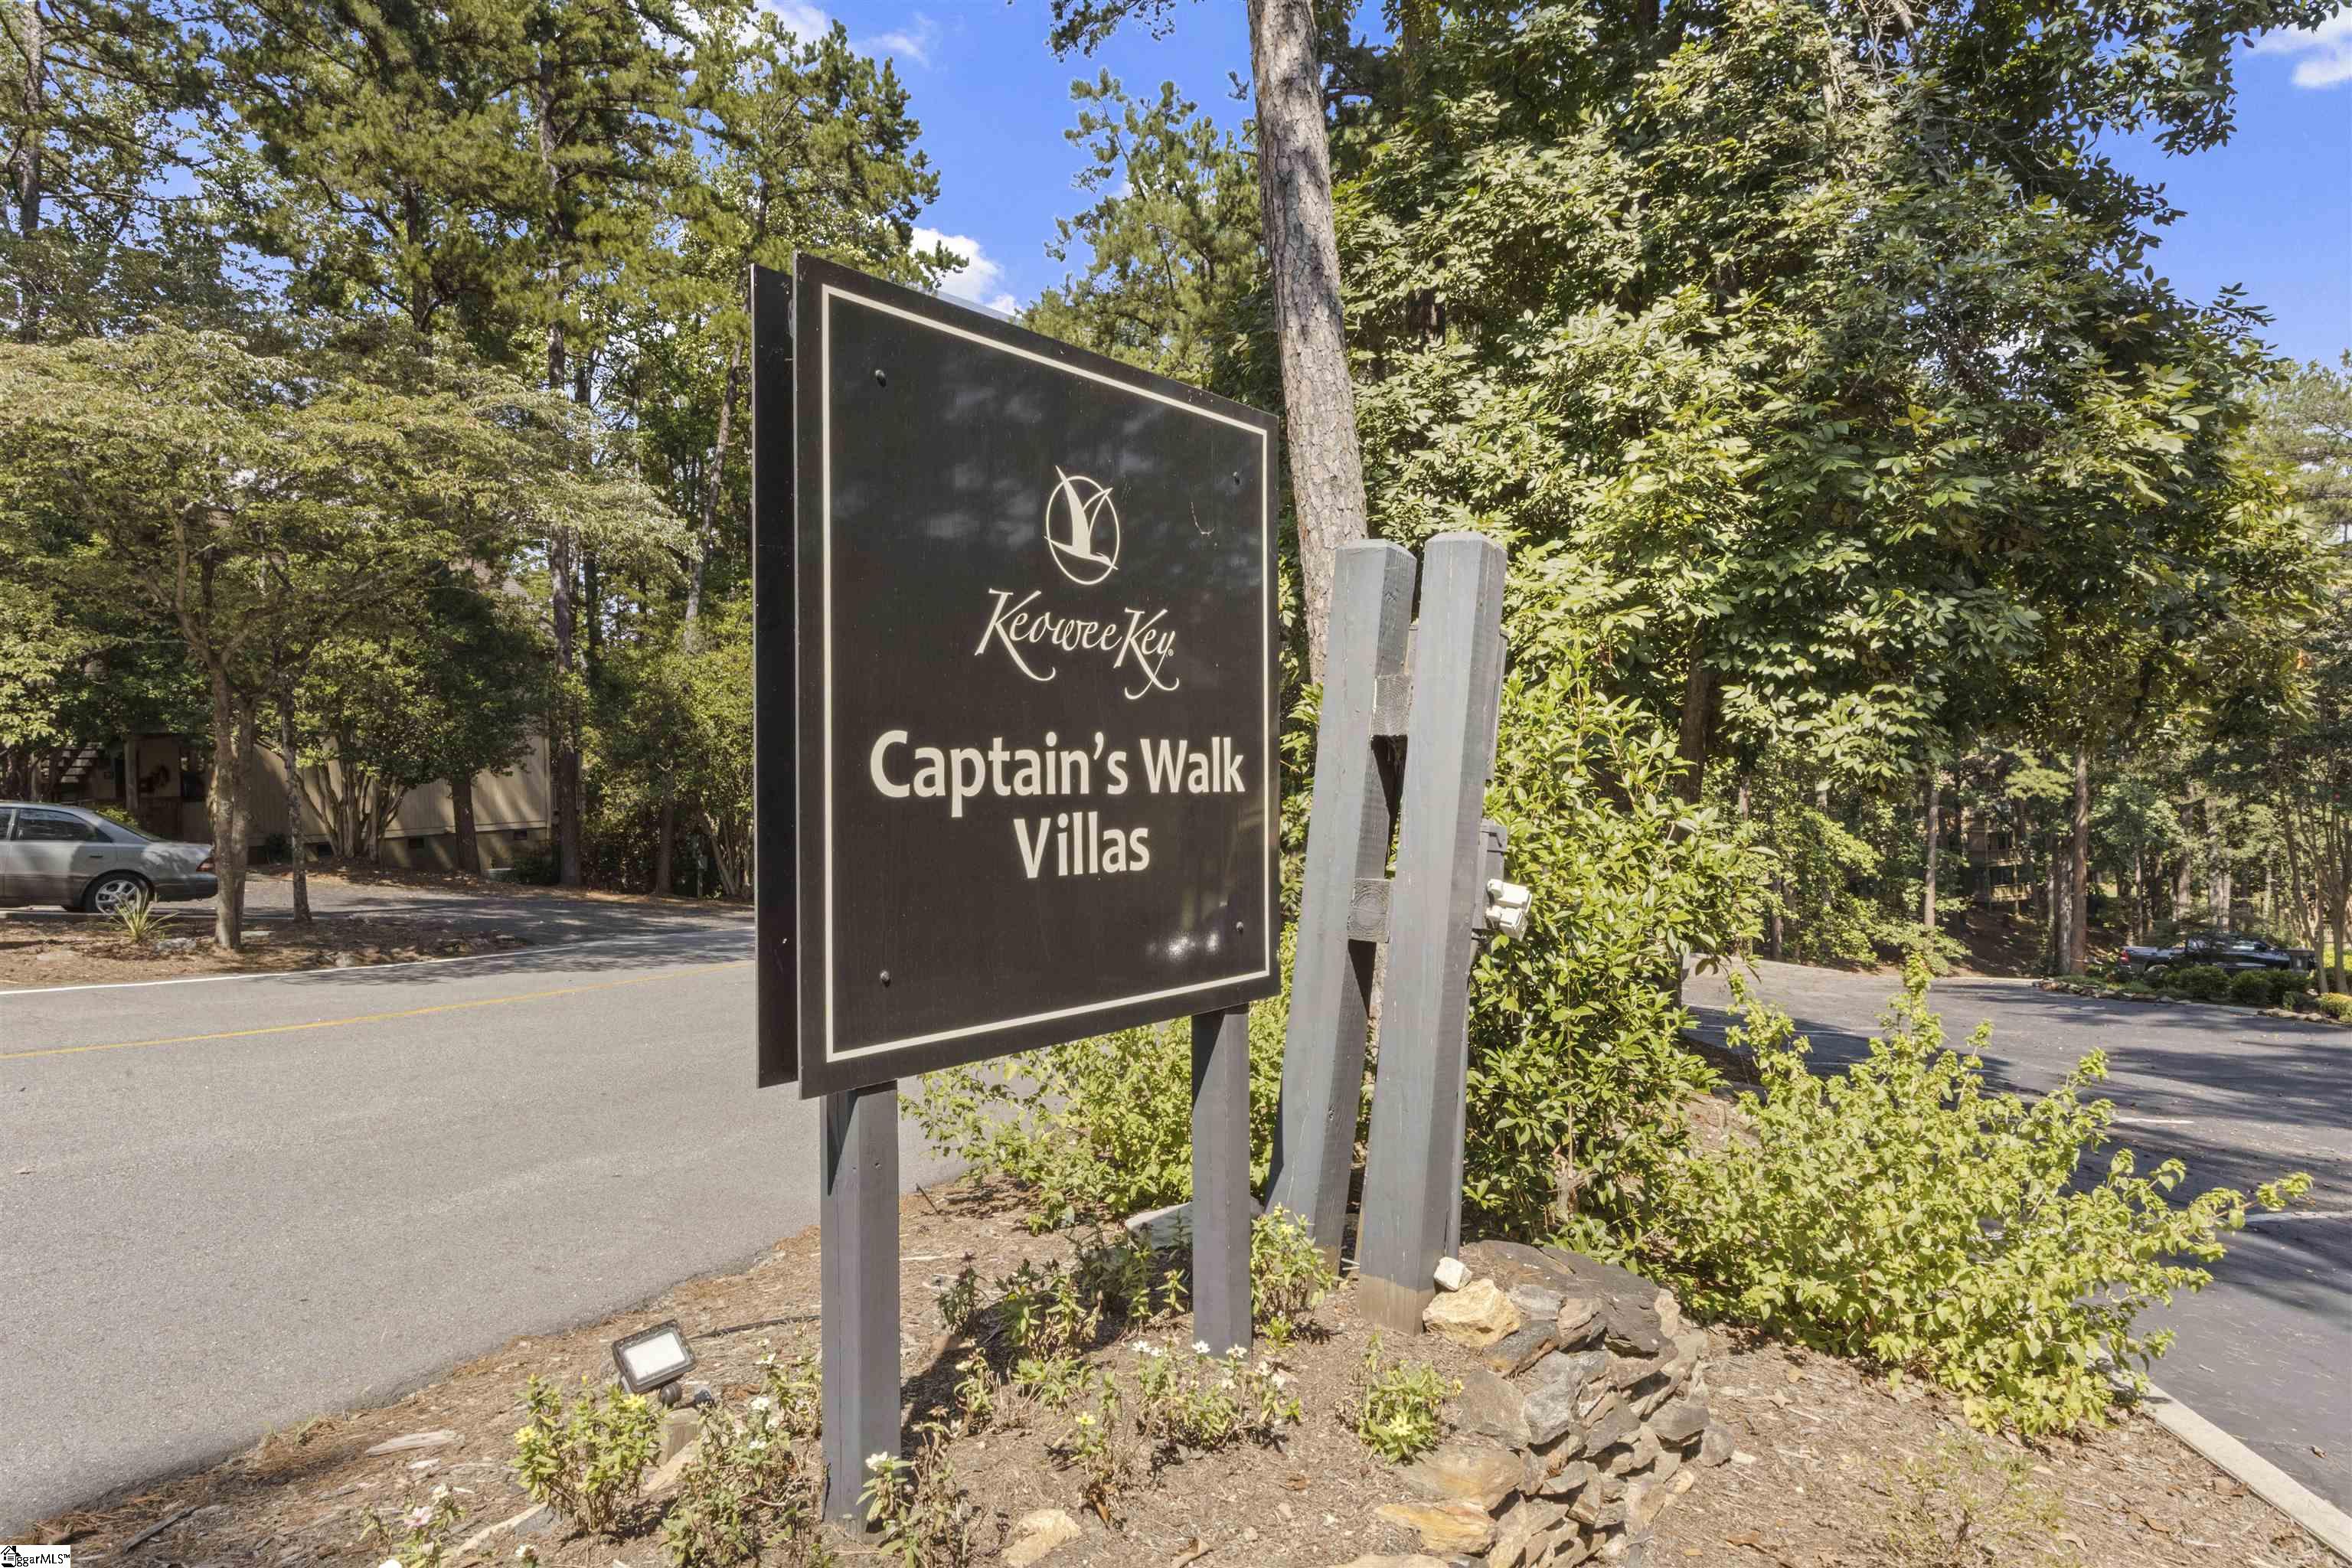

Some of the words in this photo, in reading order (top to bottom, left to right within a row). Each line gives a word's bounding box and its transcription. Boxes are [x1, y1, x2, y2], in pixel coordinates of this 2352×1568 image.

[975, 587, 1122, 681] Keowee
[870, 730, 1129, 818] Captain's
[1139, 737, 1246, 794] Walk
[1013, 812, 1150, 879] Villas
